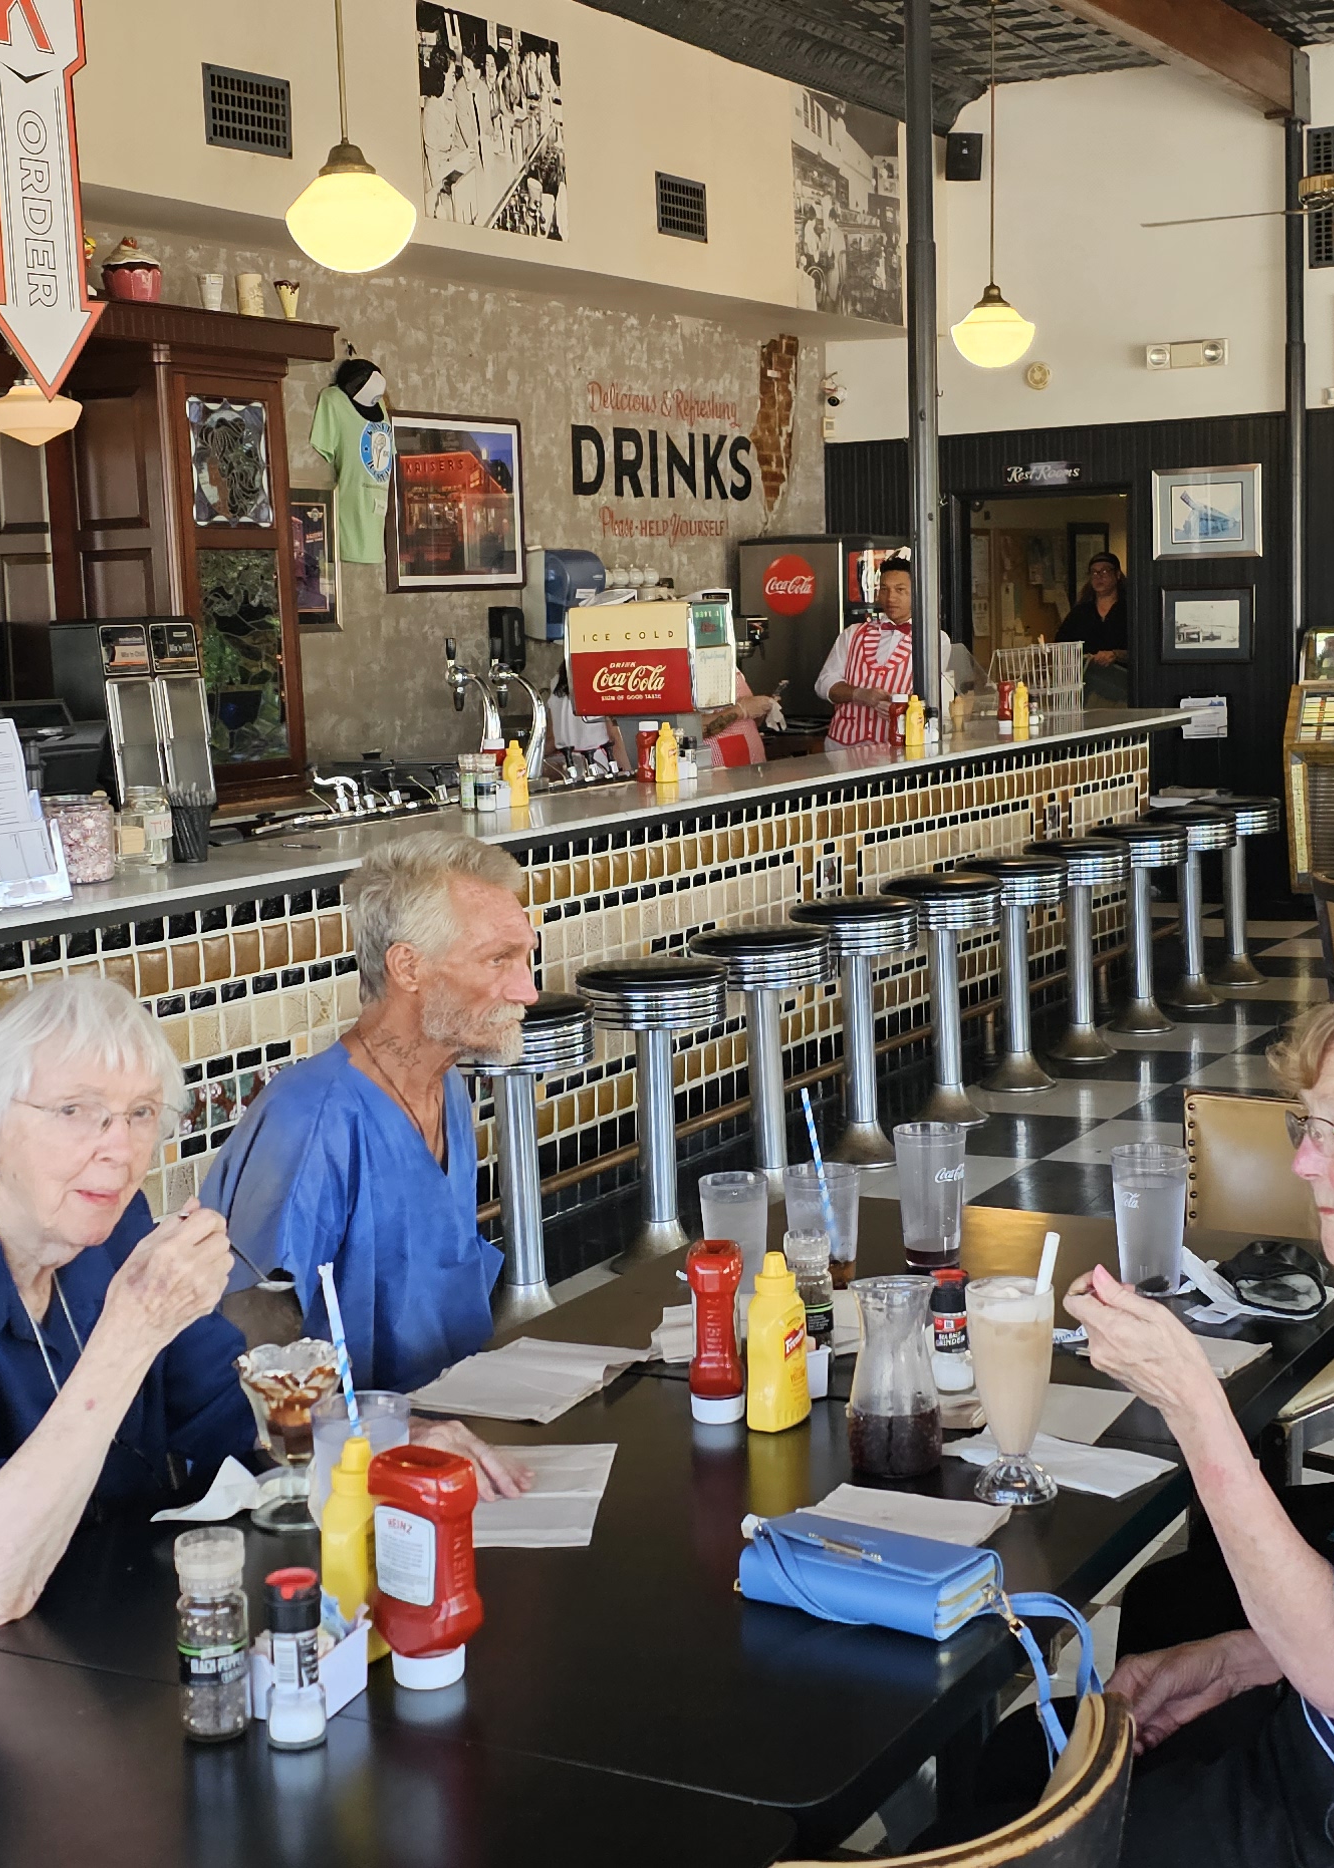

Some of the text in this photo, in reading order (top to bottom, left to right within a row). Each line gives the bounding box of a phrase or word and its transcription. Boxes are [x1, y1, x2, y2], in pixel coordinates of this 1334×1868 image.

[17, 109, 60, 309] ORDER
[586, 380, 742, 429] Delicious & Refreshing
[406, 458, 465, 474] KAISERS
[570, 423, 753, 502] DRINKS
[1007, 464, 1081, 484] Rest Rooms
[764, 575, 816, 596] Coca-Cola
[582, 630, 675, 642] ICE COLD
[592, 664, 667, 693] Coca-Cola
